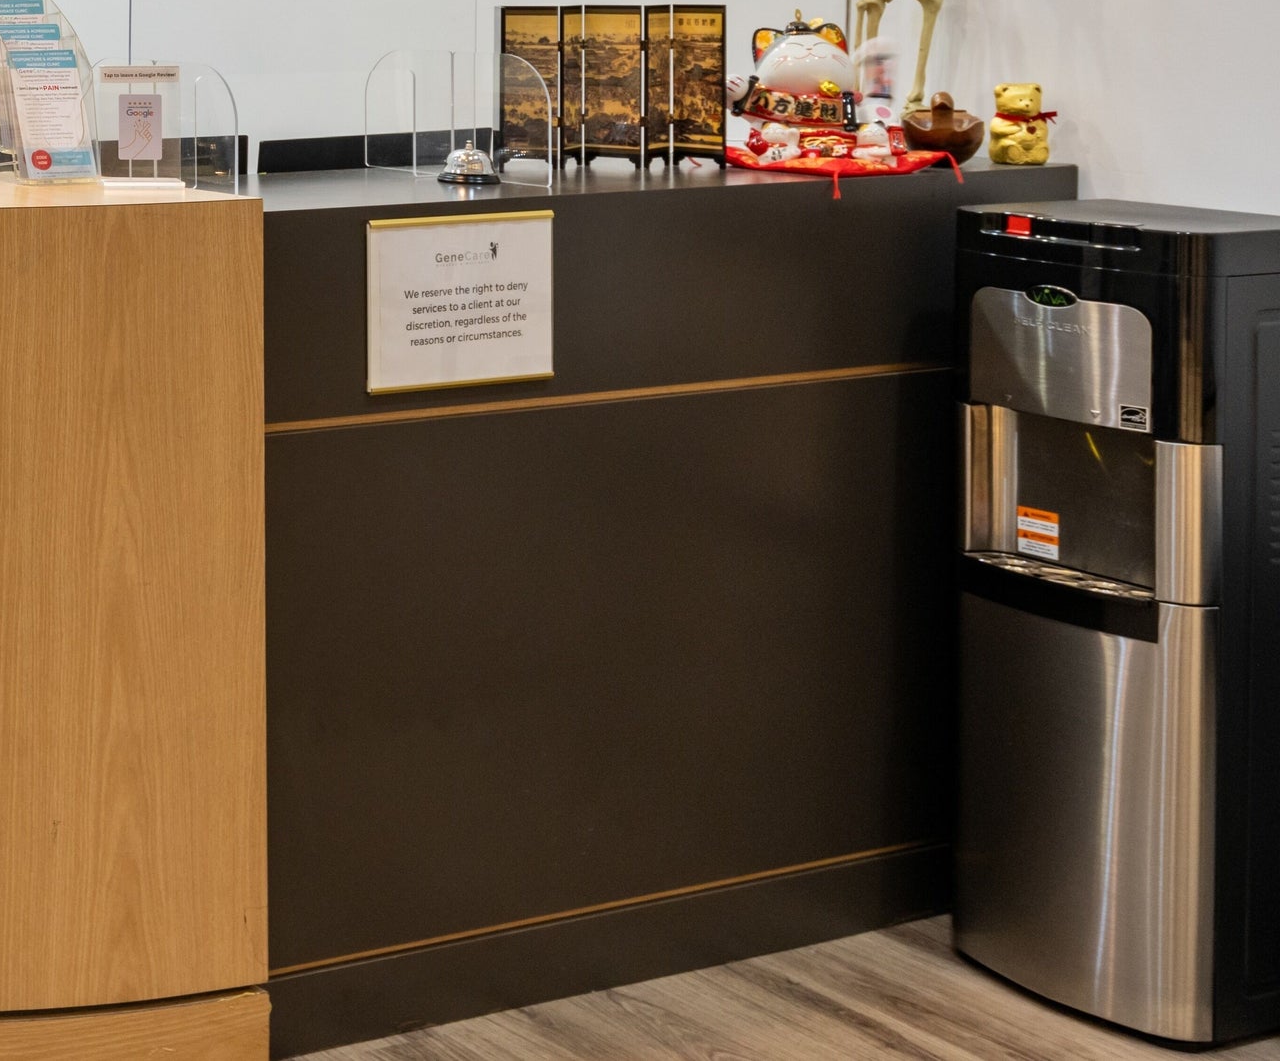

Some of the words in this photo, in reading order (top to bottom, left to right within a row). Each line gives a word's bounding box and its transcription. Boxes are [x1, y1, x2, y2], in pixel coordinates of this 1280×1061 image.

[126, 109, 154, 118] Google
[435, 250, 490, 263] GeneCare
[404, 290, 420, 299] We
[421, 288, 452, 298] reserve
[455, 286, 470, 295] the
[472, 284, 493, 296] right
[495, 284, 505, 292] to
[506, 282, 528, 292] deny
[412, 304, 447, 314] services
[449, 303, 459, 312] to
[468, 300, 492, 310] client
[494, 300, 504, 308] at
[506, 298, 520, 307] our
[406, 319, 453, 331] discretion,
[454, 314, 500, 328] regardless
[502, 312, 512, 322] of
[512, 312, 528, 321] the
[1047, 321, 1091, 336] CLEAN
[410, 335, 444, 346] reasons
[446, 335, 456, 343] or
